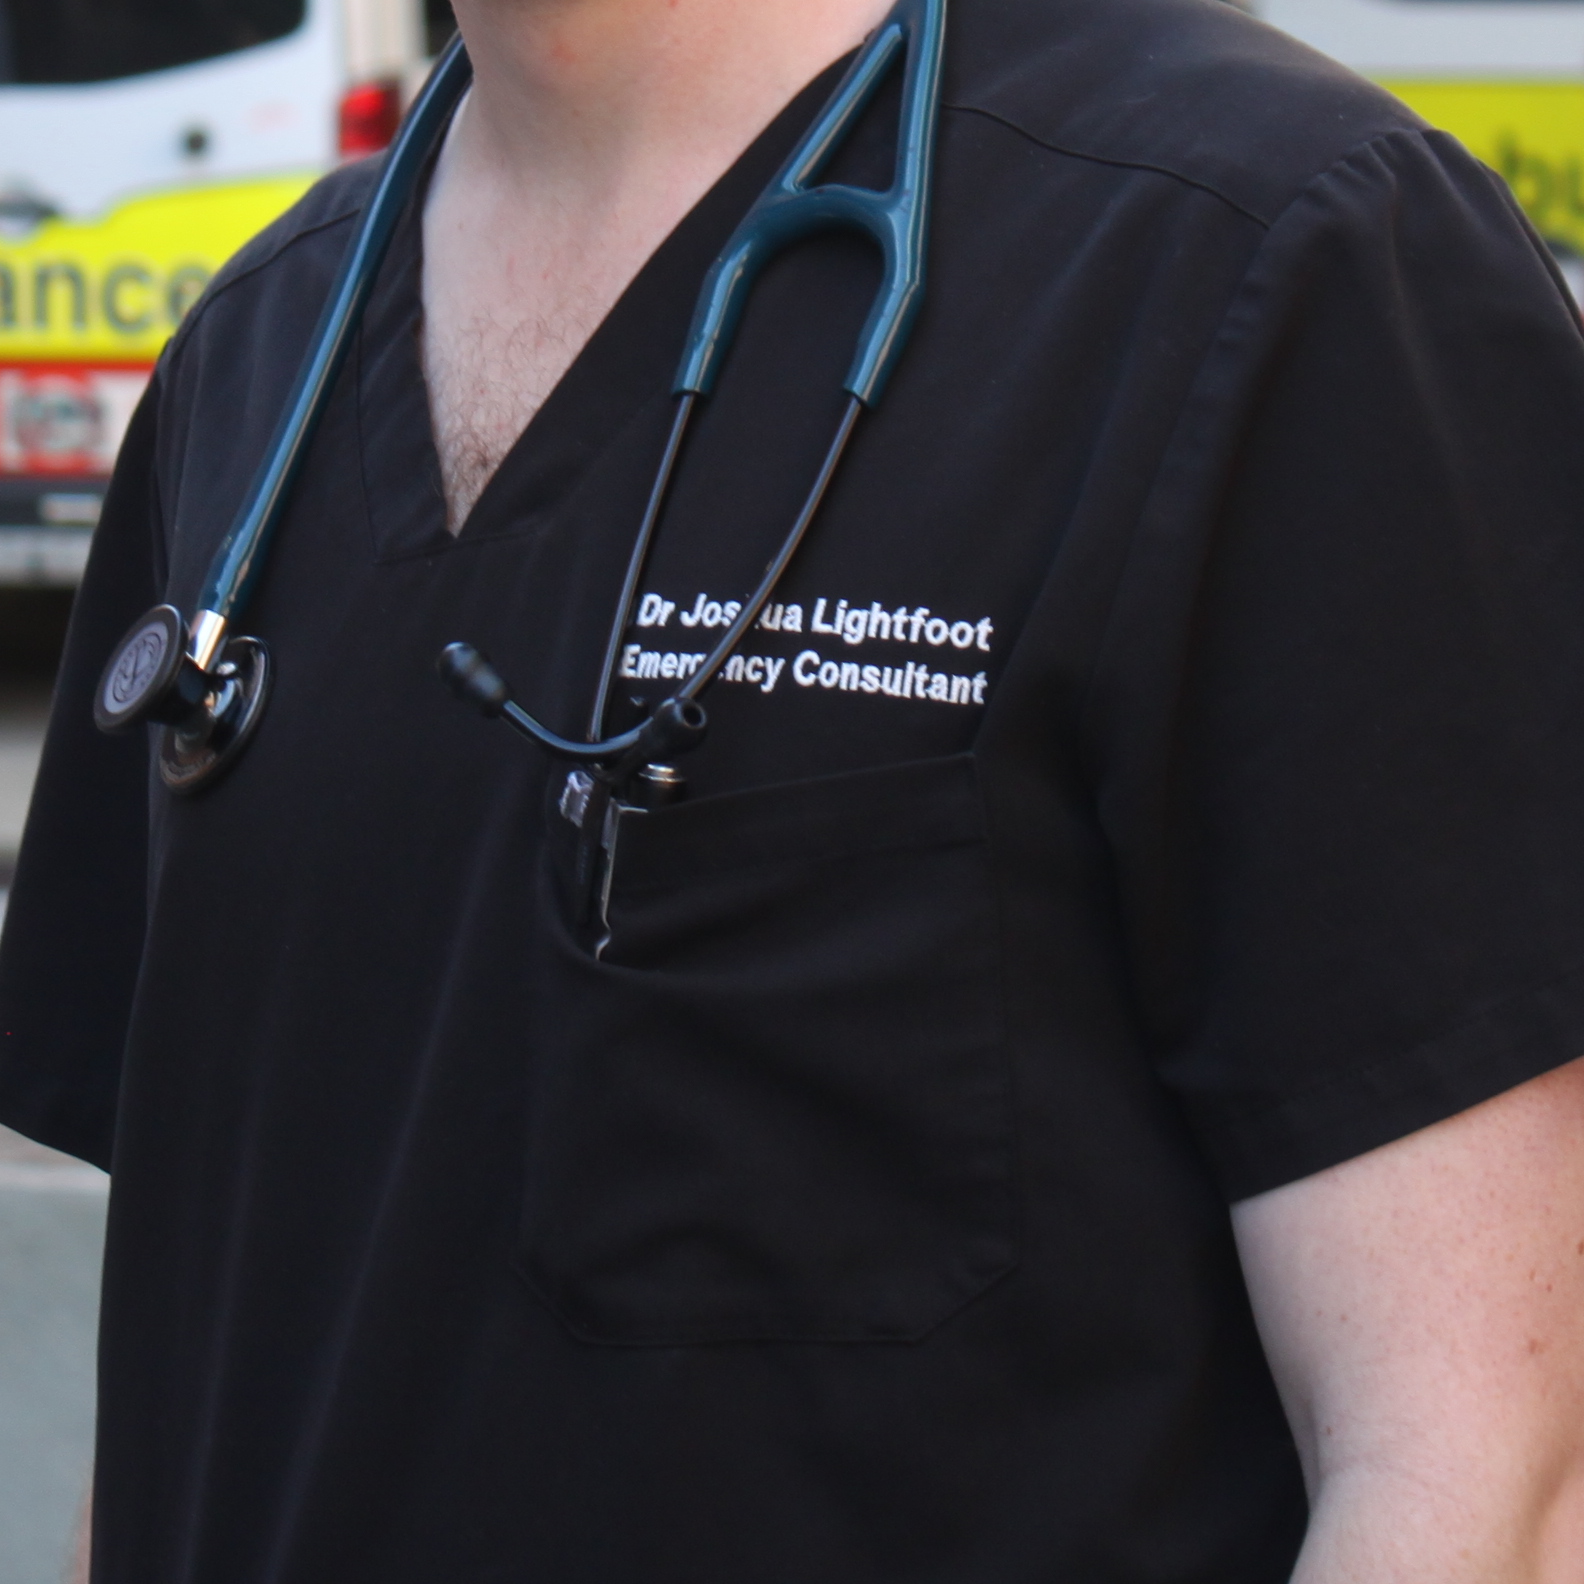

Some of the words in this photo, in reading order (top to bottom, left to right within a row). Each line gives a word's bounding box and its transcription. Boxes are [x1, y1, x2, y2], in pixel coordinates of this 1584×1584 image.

[636, 592, 676, 629] Dr
[680, 592, 803, 634] Josua
[811, 597, 994, 652] Lightfoot
[619, 643, 786, 693] Emerncy
[792, 649, 989, 705] Consultant
